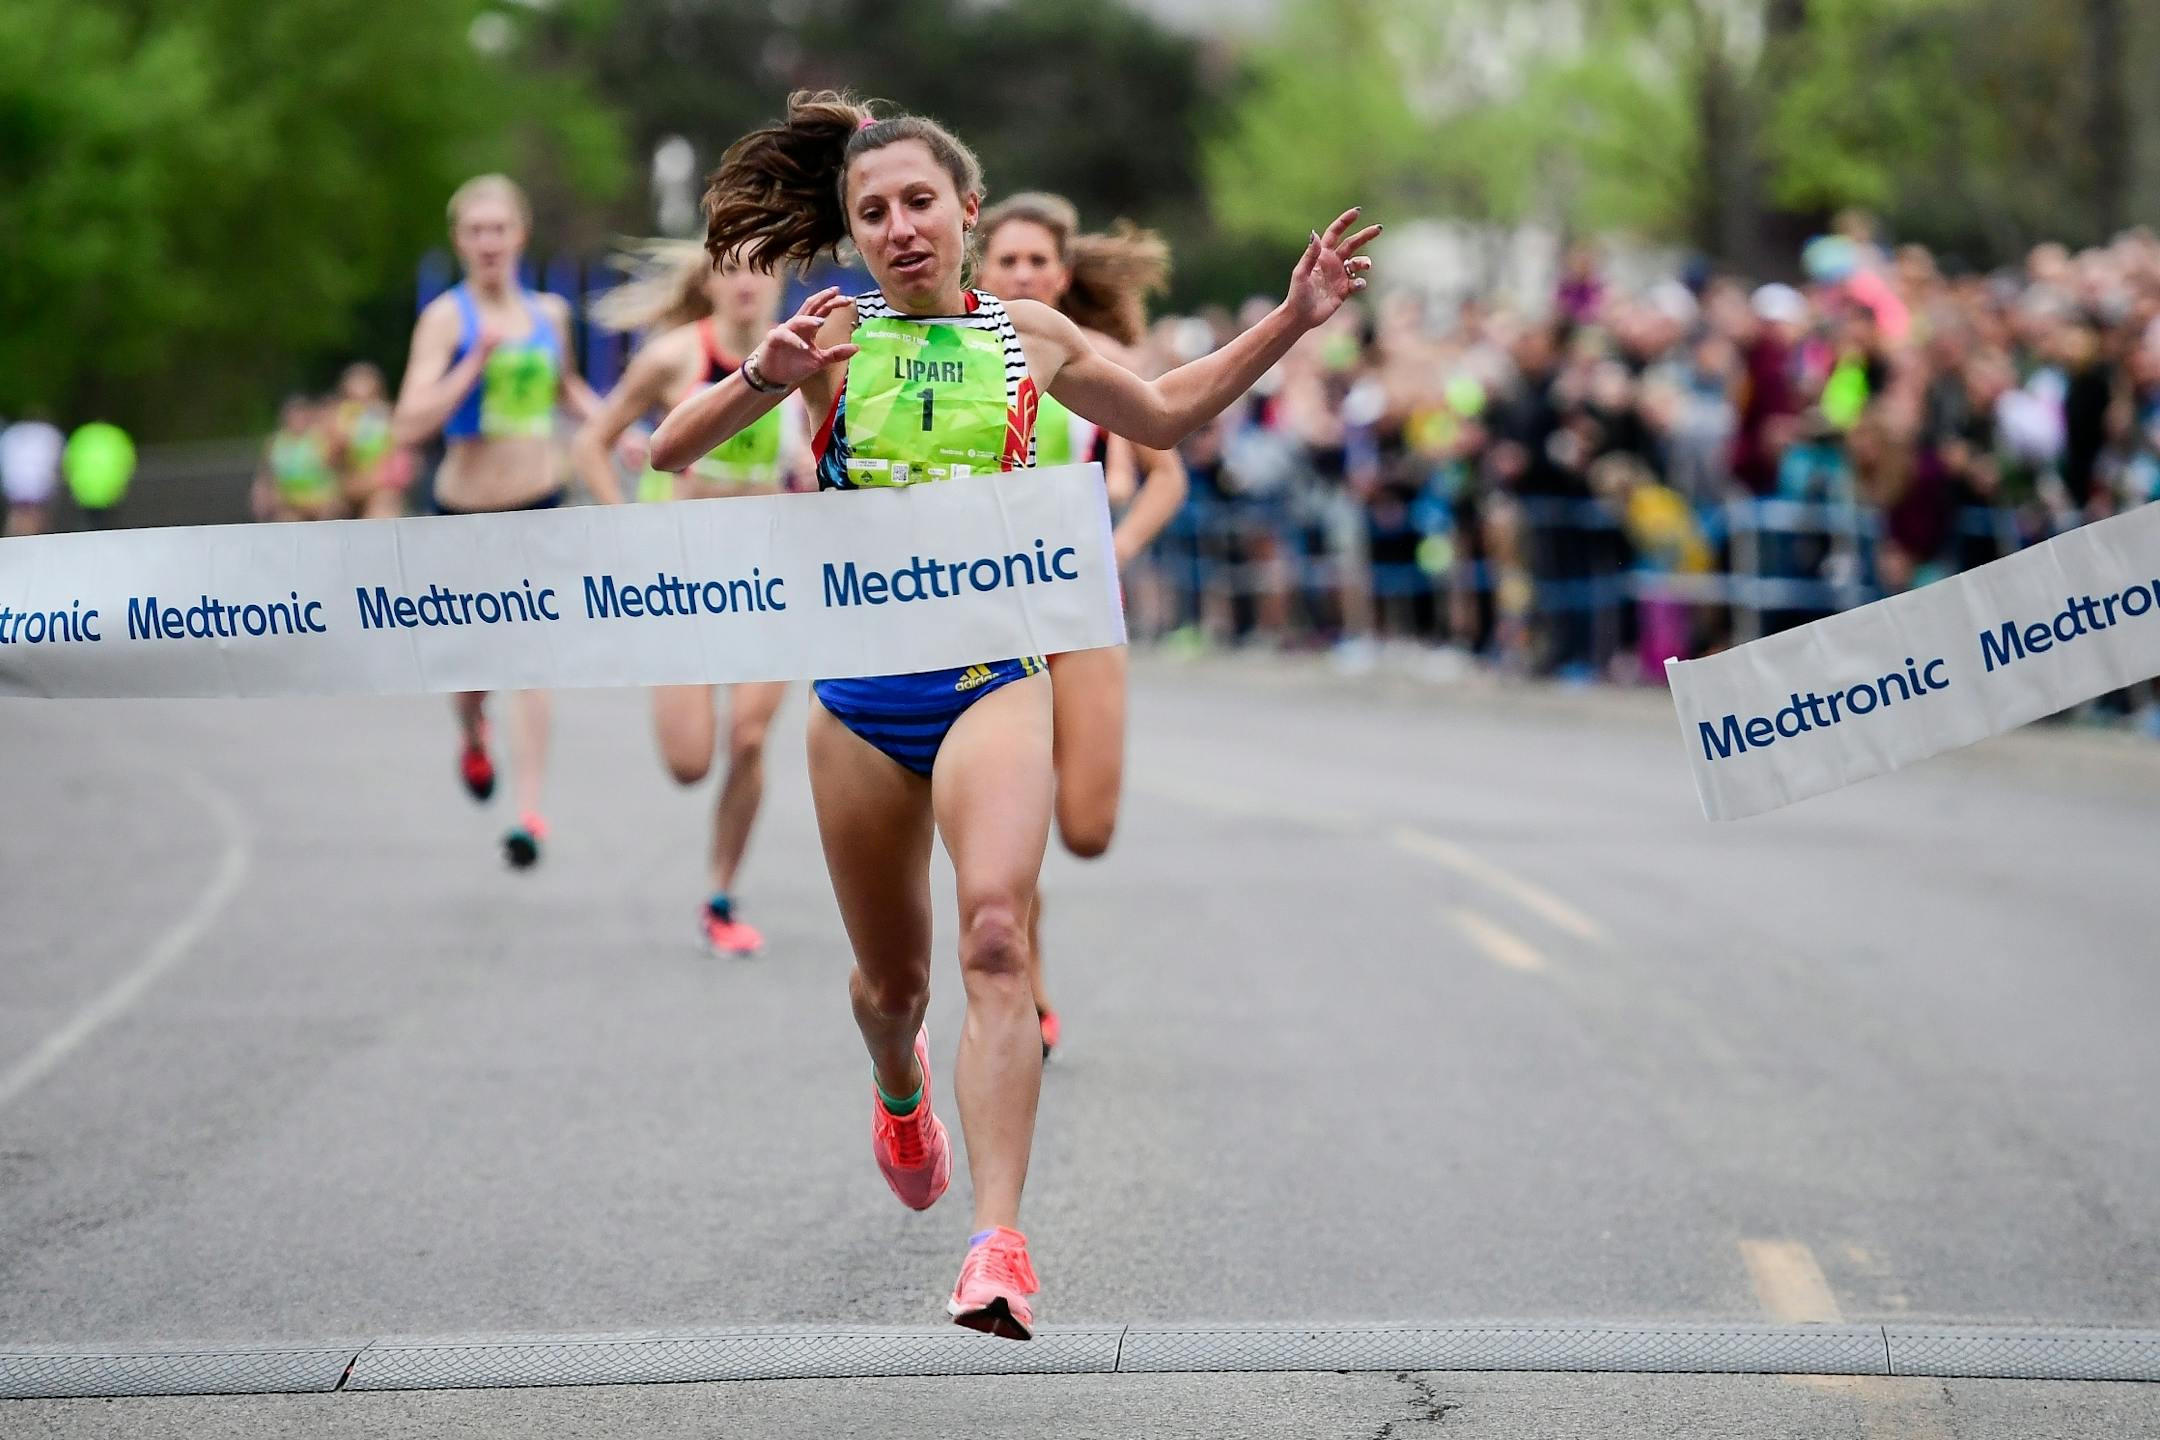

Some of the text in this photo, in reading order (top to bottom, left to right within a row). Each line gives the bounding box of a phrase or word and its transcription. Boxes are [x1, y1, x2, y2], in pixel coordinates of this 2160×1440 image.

[894, 356, 963, 383] LIPARI
[916, 387, 934, 431] 1
[0, 538, 1079, 645] tronic Medtronic Medtronic Medtronic Medtronic
[1698, 657, 1950, 761] Medtronic
